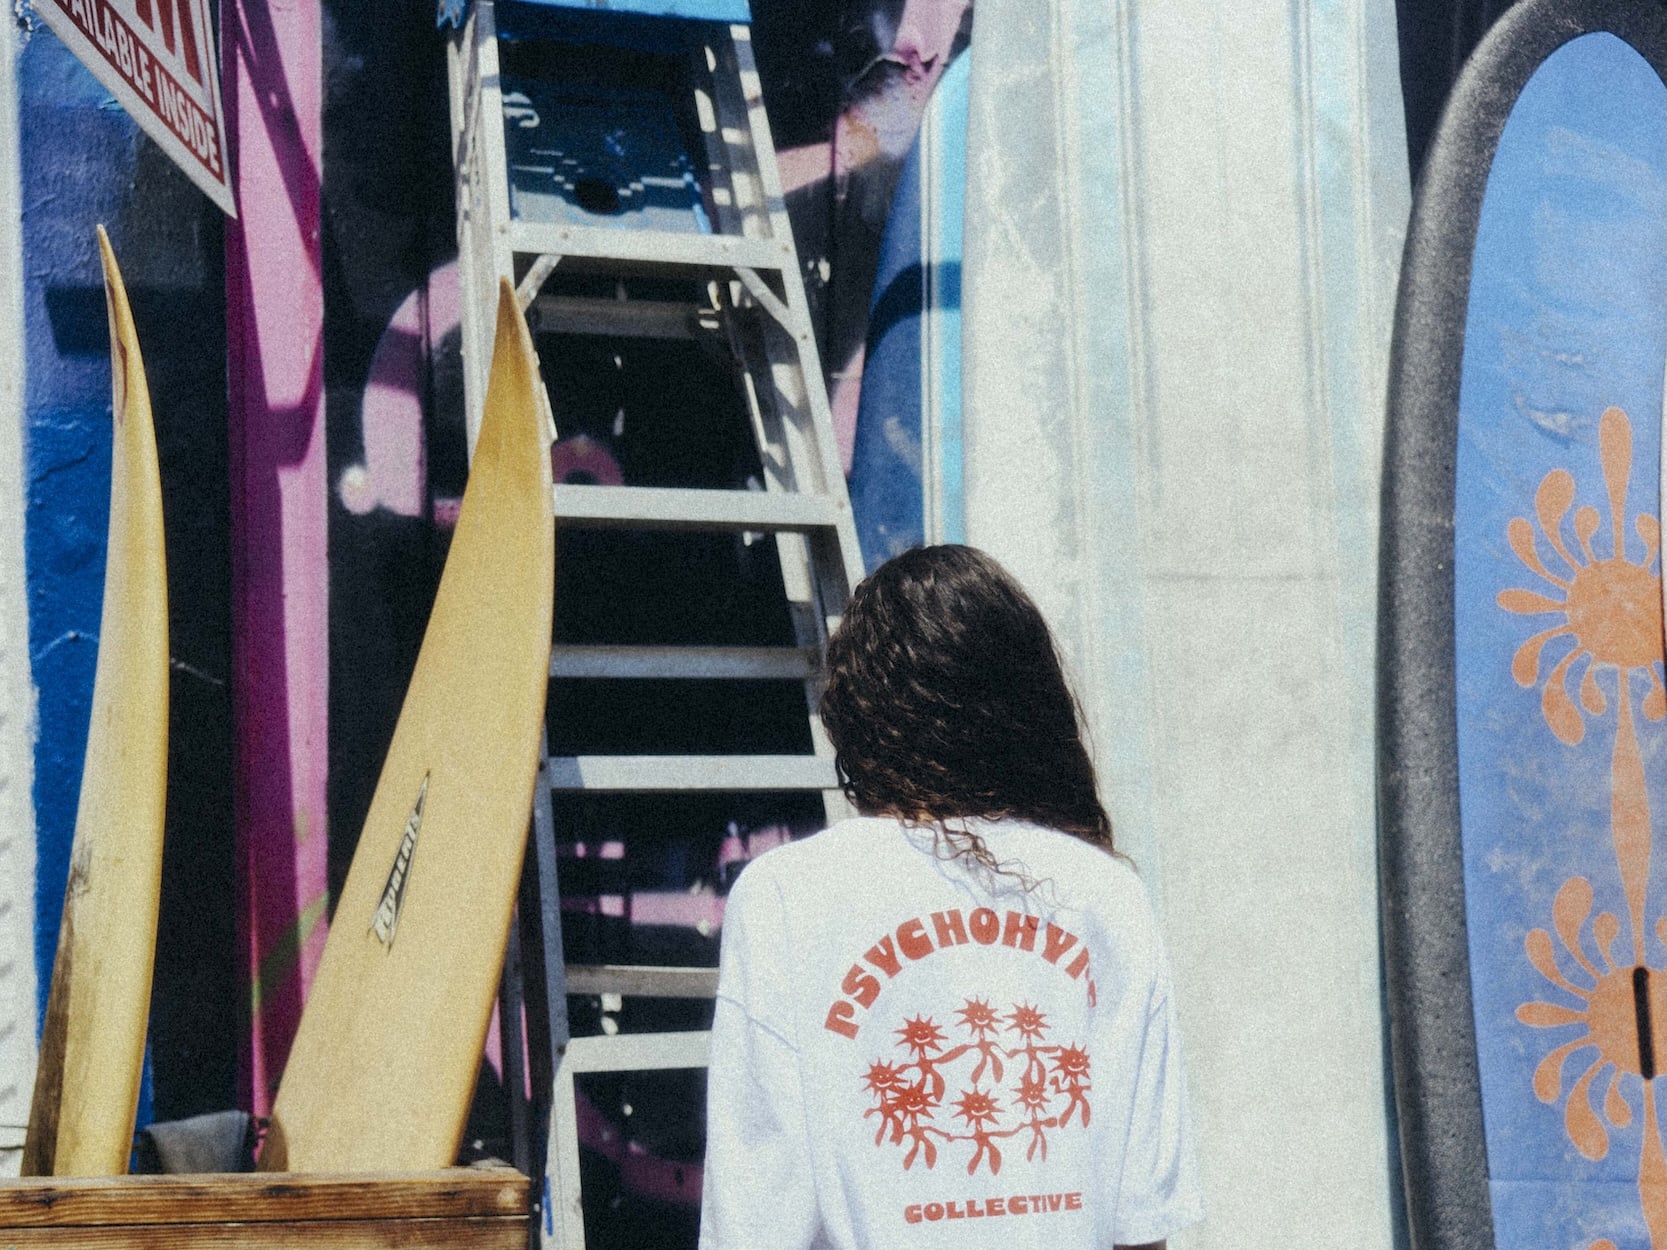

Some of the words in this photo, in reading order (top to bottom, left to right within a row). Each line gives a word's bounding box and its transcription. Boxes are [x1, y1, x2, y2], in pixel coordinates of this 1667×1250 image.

[57, 0, 154, 104] AILABLE
[154, 64, 220, 173] INSIDE
[903, 1191, 1083, 1224] COLLECTIVE
